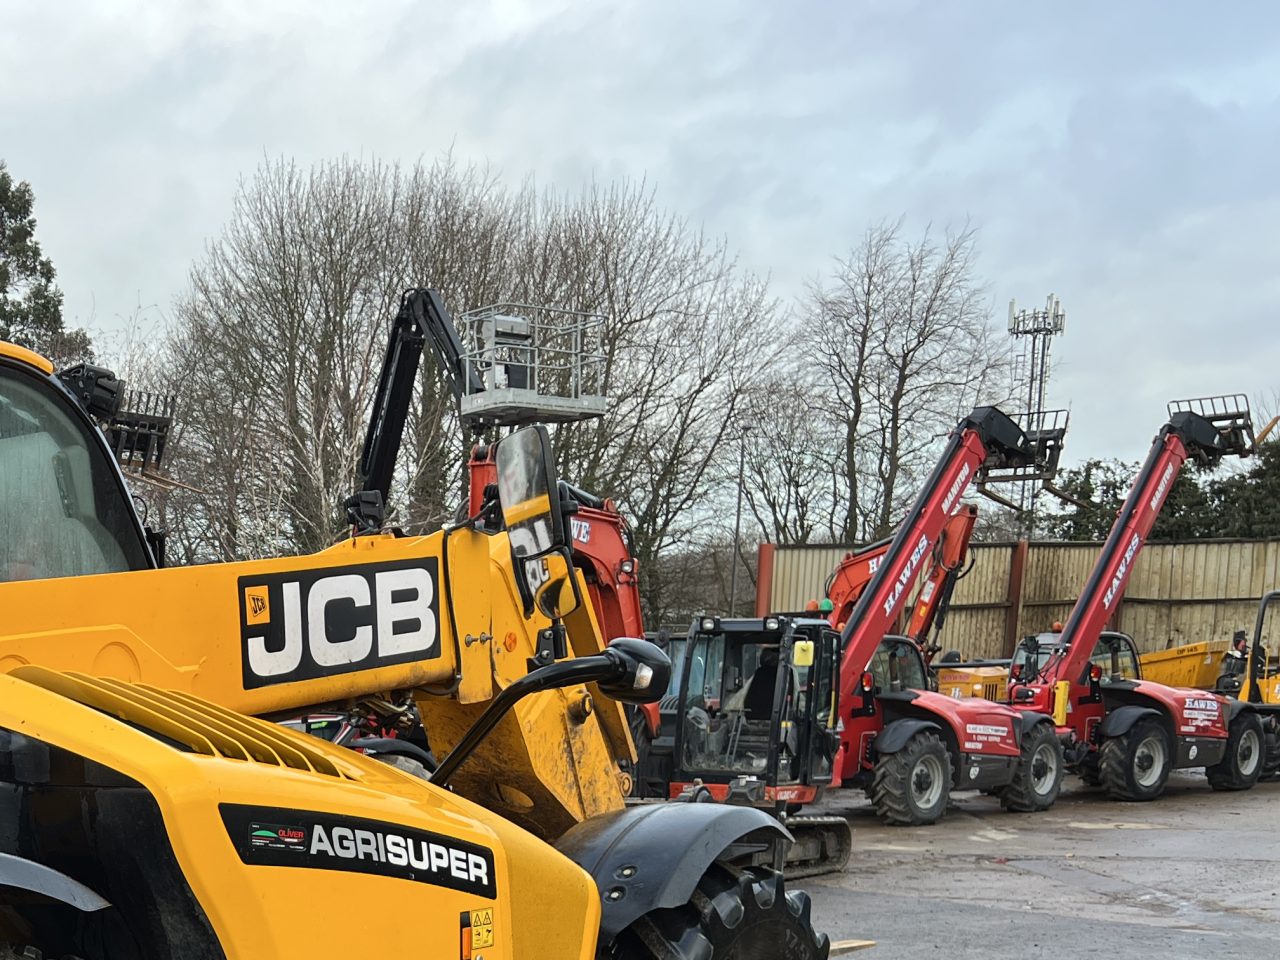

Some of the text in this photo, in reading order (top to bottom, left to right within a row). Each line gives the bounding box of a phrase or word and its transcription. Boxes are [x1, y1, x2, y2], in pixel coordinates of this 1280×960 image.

[251, 596, 267, 615] JCB
[883, 533, 928, 617] HAWES
[1103, 532, 1140, 610] HAWES
[248, 568, 436, 677] JCB
[309, 824, 489, 885] AGRISUPER
